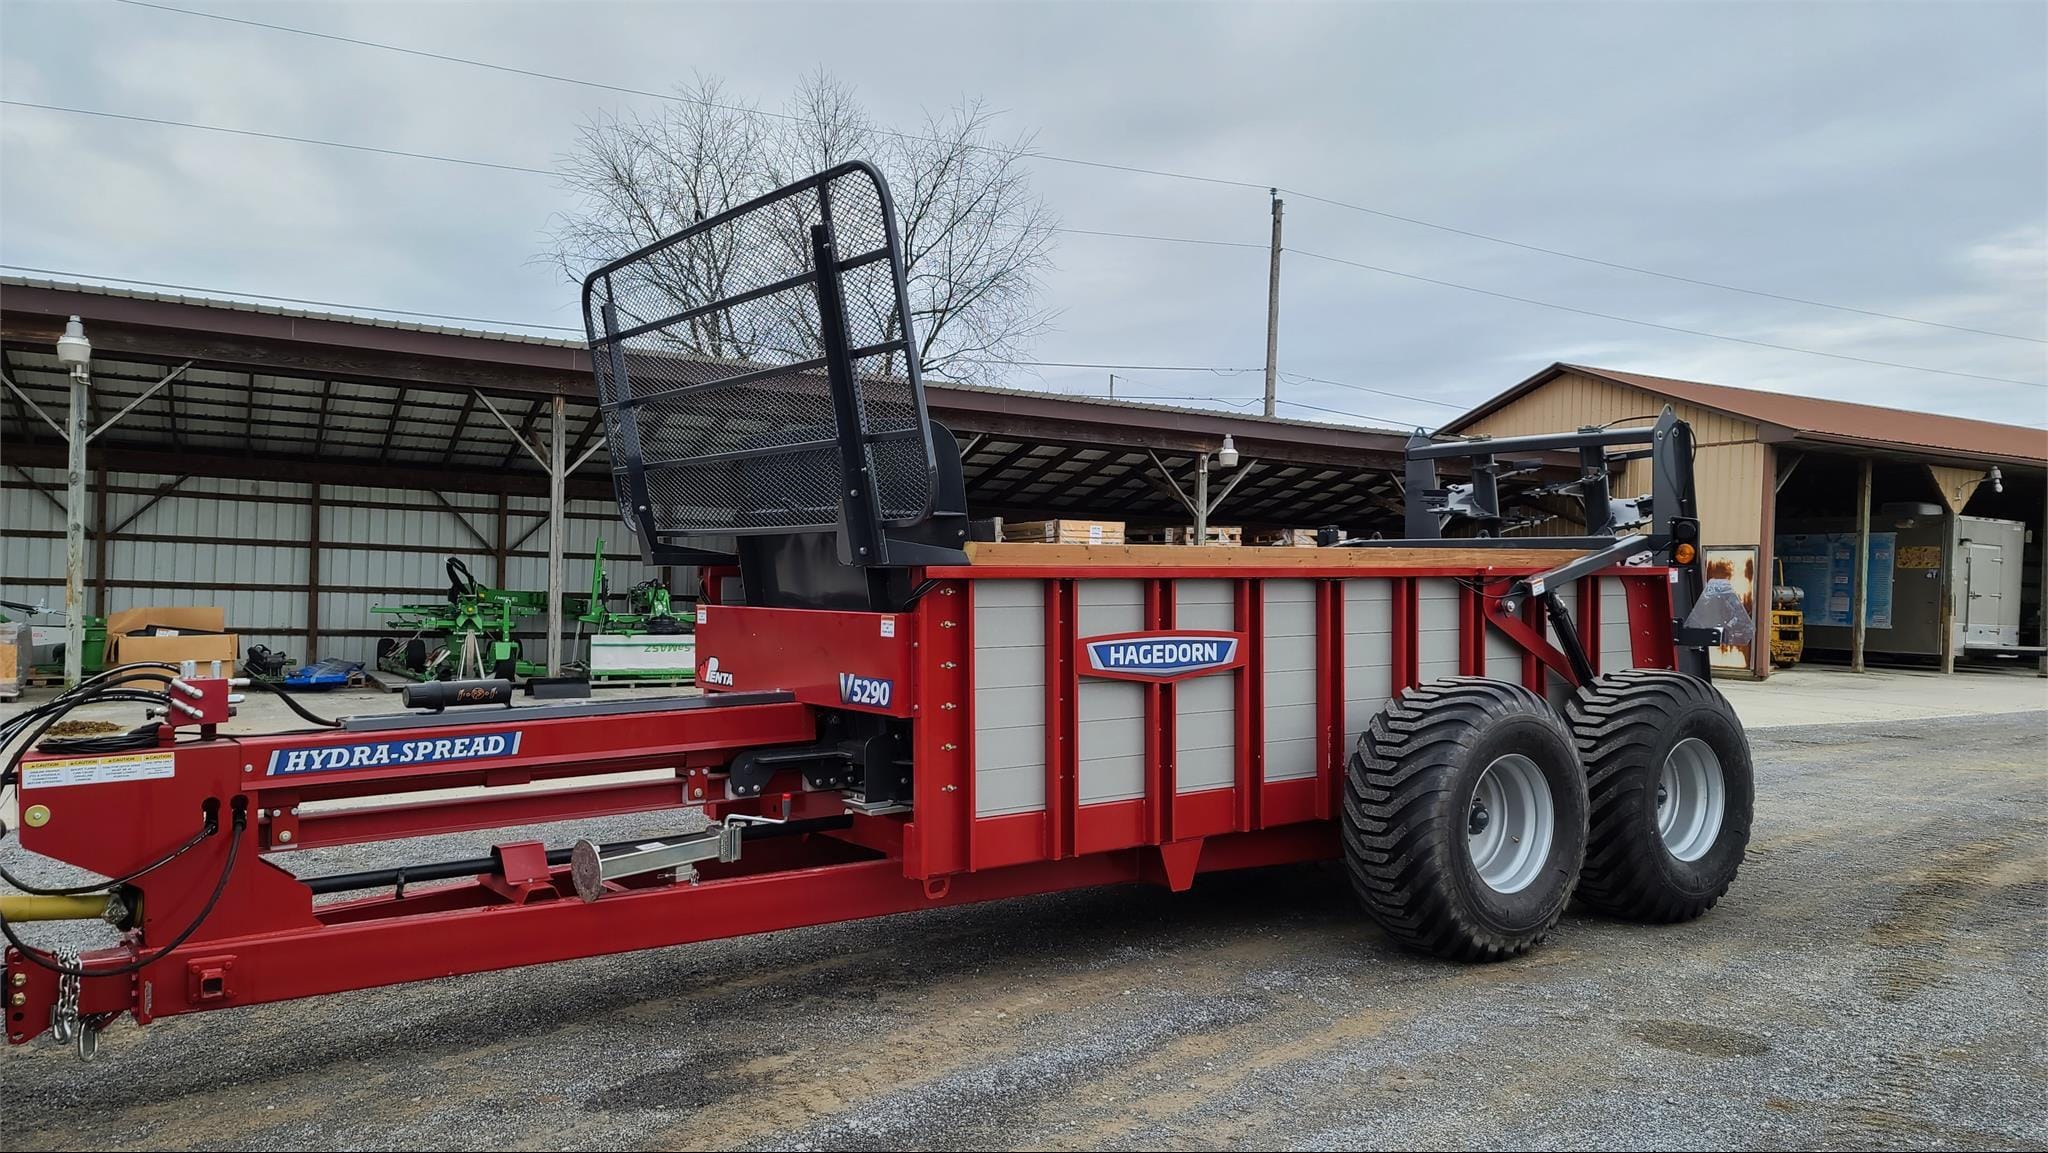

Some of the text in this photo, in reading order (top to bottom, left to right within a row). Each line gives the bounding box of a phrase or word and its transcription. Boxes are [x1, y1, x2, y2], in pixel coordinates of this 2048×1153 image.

[1110, 642, 1218, 666] HAGEDORN
[705, 656, 734, 686] PENTA
[839, 672, 890, 706] V5290
[284, 735, 505, 772] HYDRA-SPREAD
